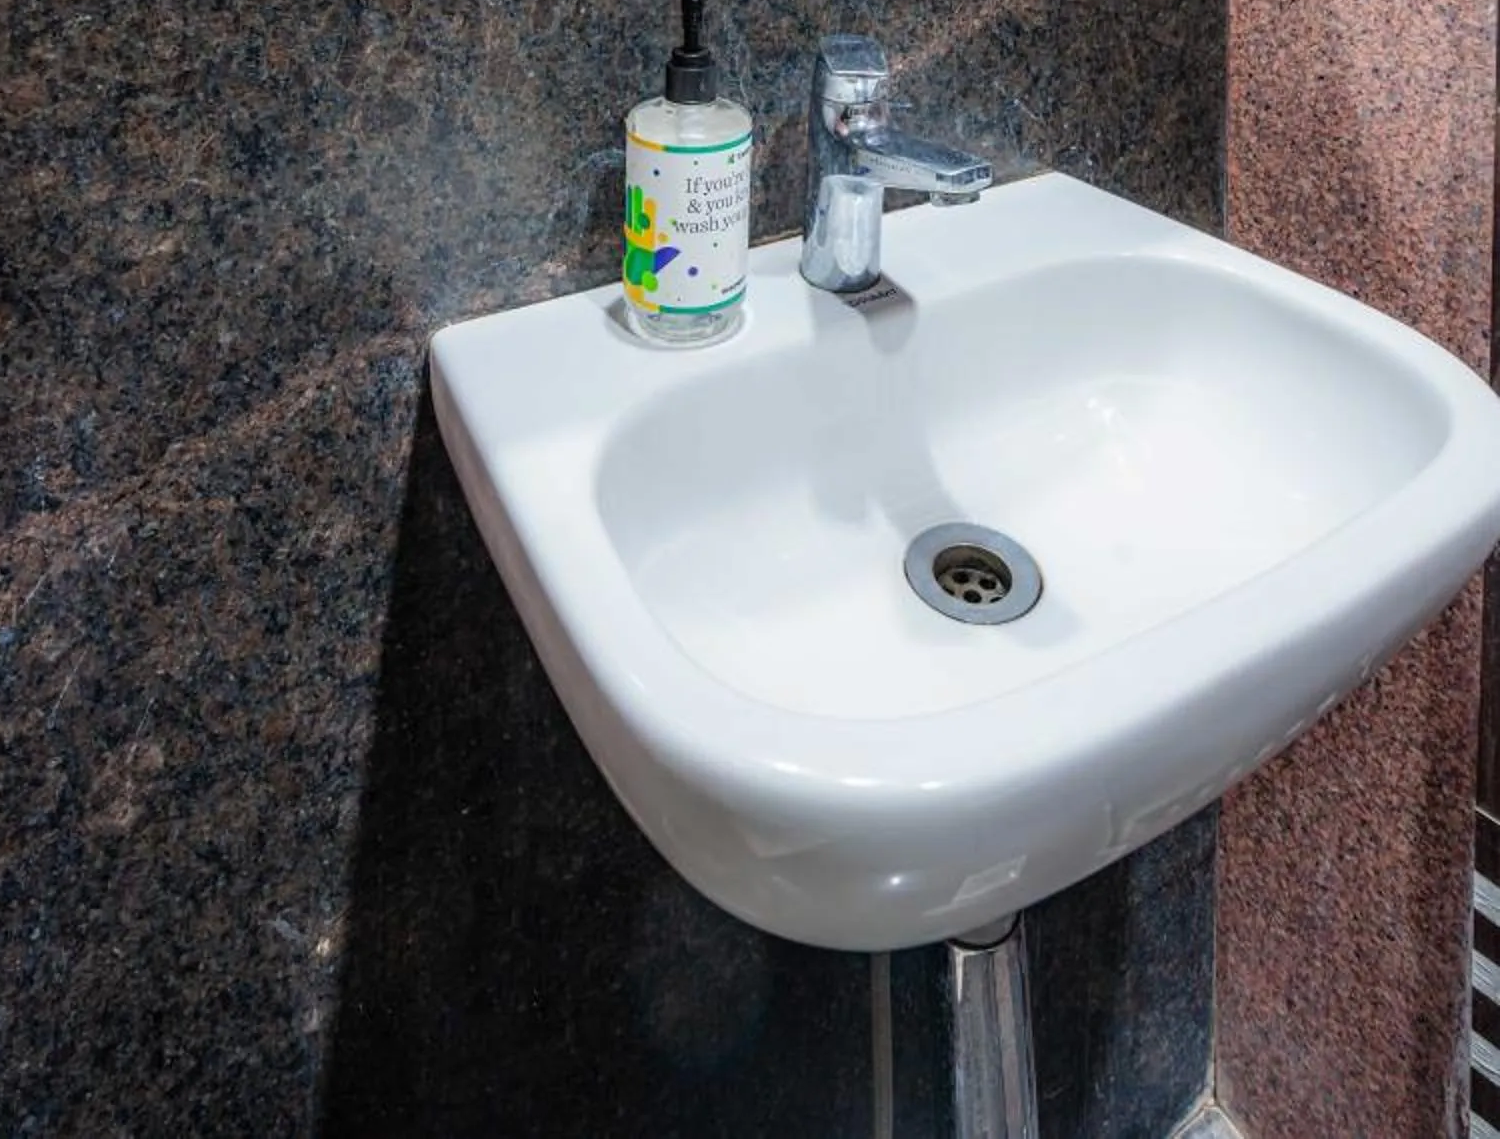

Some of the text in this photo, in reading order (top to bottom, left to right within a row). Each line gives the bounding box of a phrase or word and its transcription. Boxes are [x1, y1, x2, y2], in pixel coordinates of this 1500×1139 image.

[685, 176, 702, 194] If
[687, 195, 733, 216] & you
